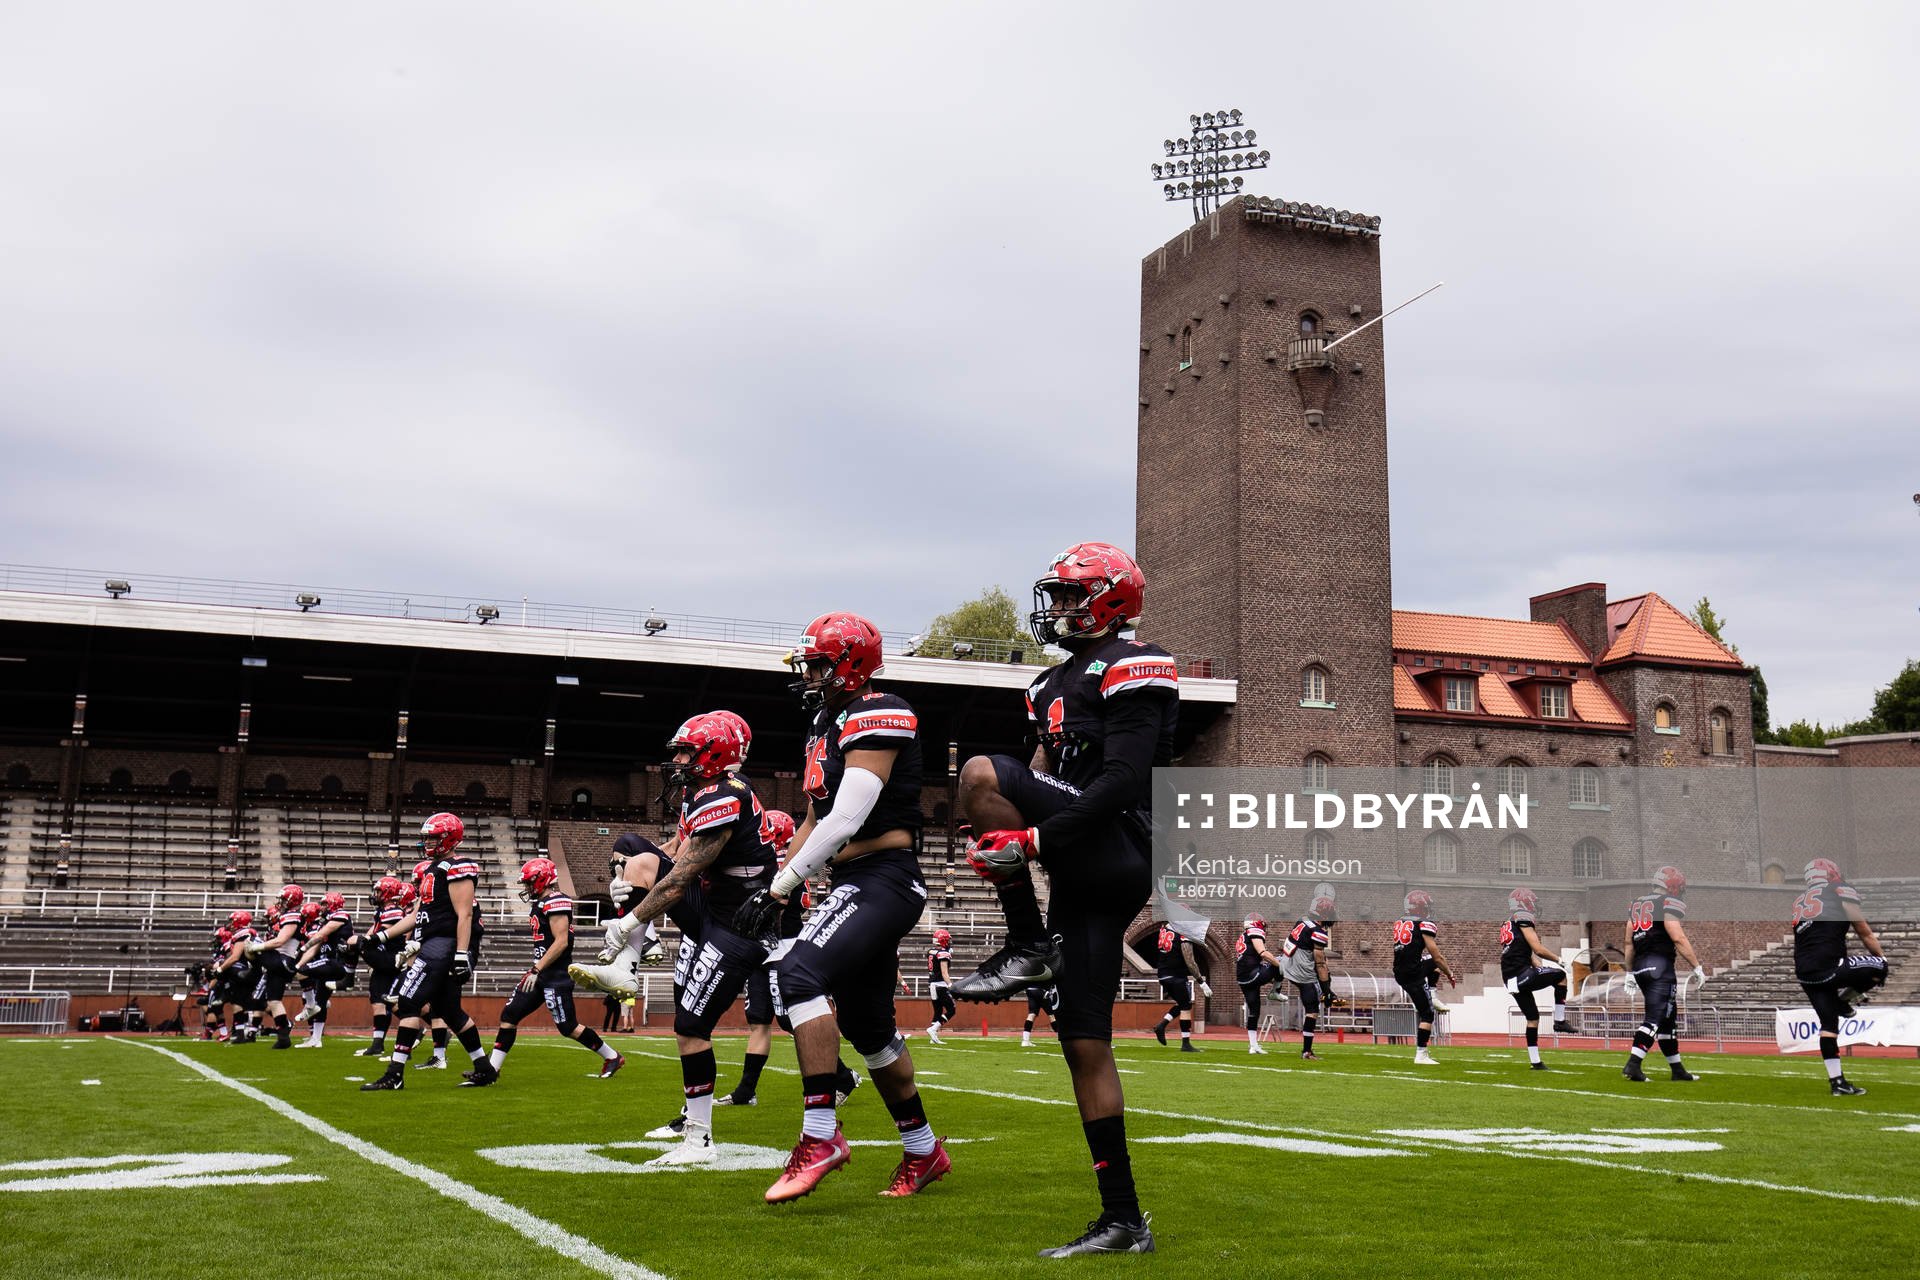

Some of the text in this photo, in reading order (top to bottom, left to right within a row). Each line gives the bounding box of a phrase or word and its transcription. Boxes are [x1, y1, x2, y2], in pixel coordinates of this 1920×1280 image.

[858, 717, 911, 729] Ninetech
[691, 804, 733, 828] Ninetech
[680, 941, 724, 1012] ELON
